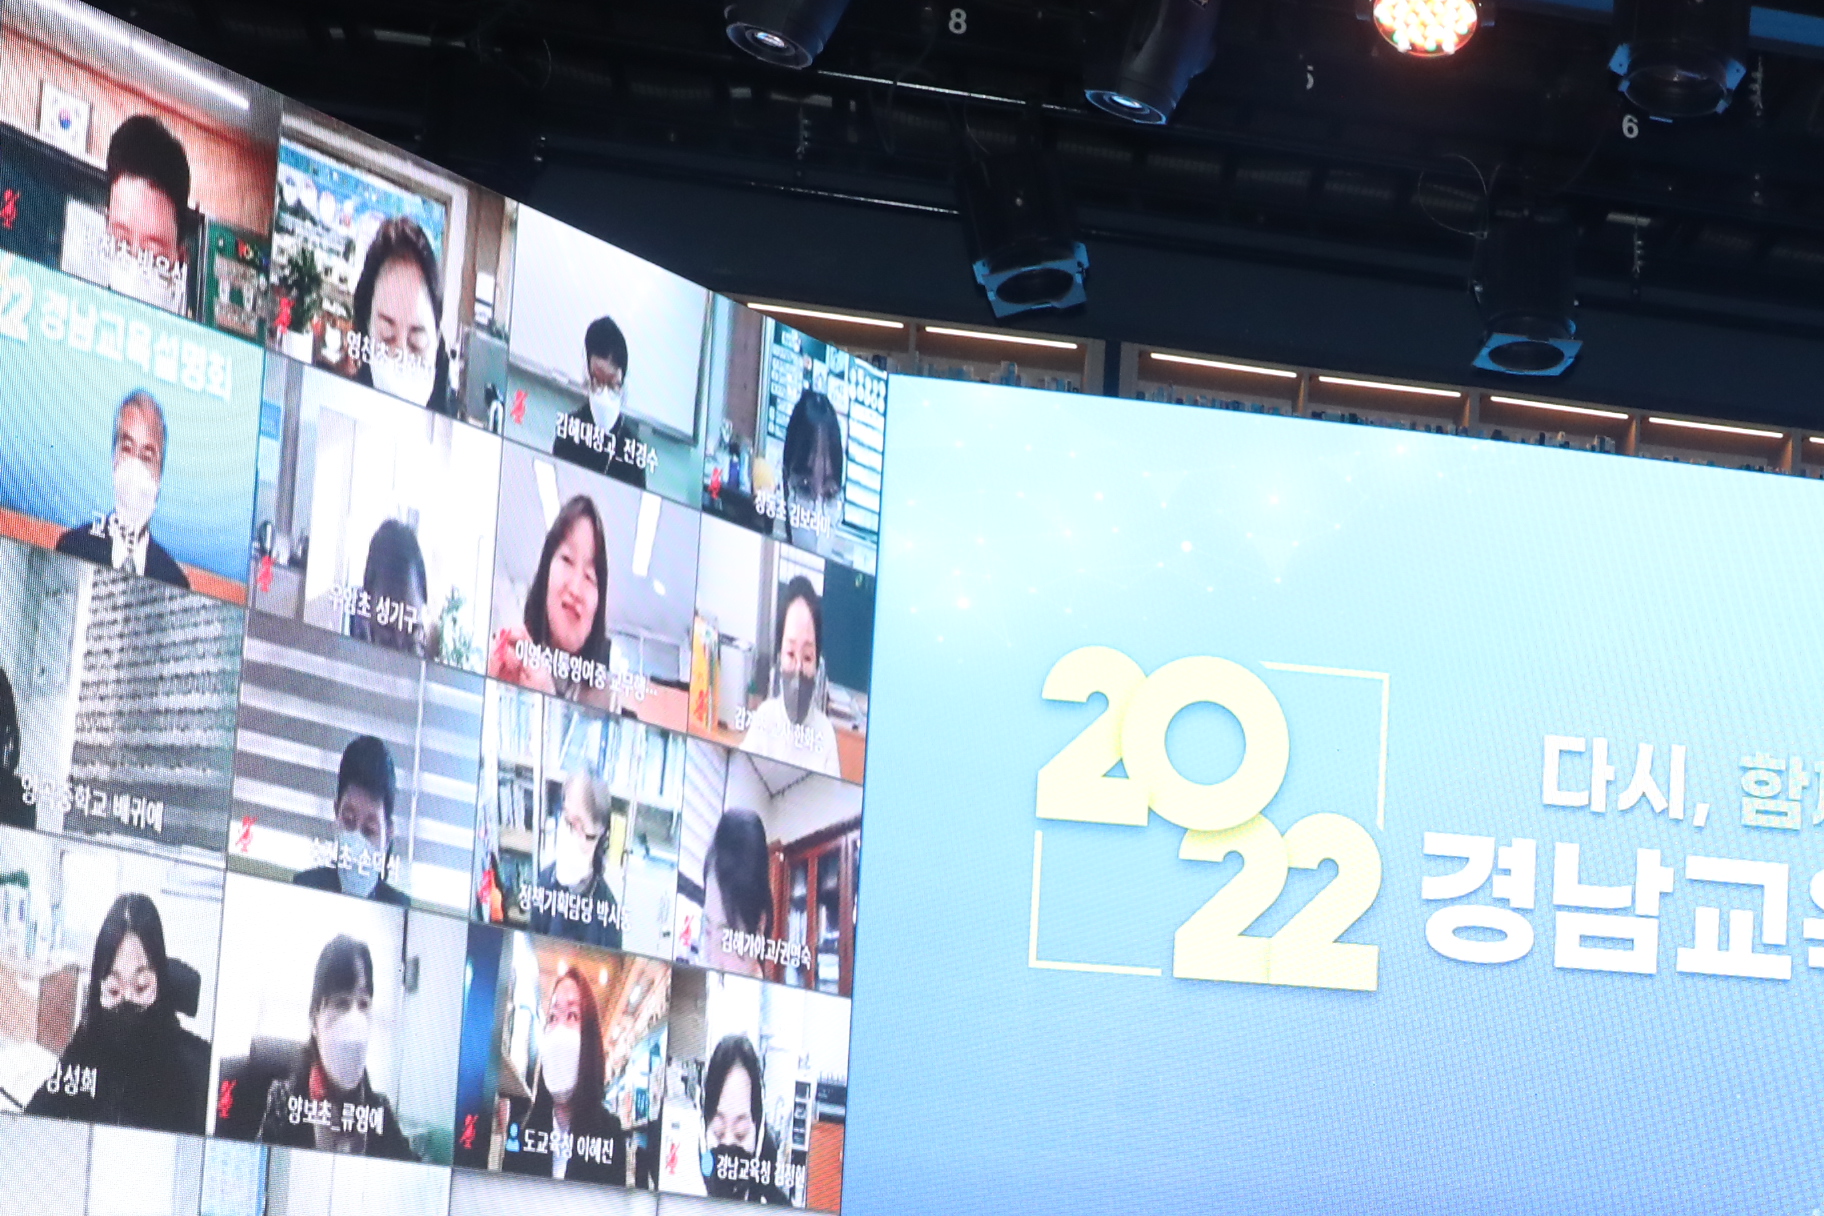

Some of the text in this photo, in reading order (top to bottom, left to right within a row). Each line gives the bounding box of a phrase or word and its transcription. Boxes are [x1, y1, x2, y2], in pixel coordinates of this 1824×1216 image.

[948, 9, 967, 35] 8
[1620, 114, 1640, 140] 6
[40, 289, 233, 400] 경남교육설명회
[1541, 735, 1711, 828] 다시,
[522, 1126, 574, 1160] 도교육청
[716, 1153, 771, 1186] 경남교육청
